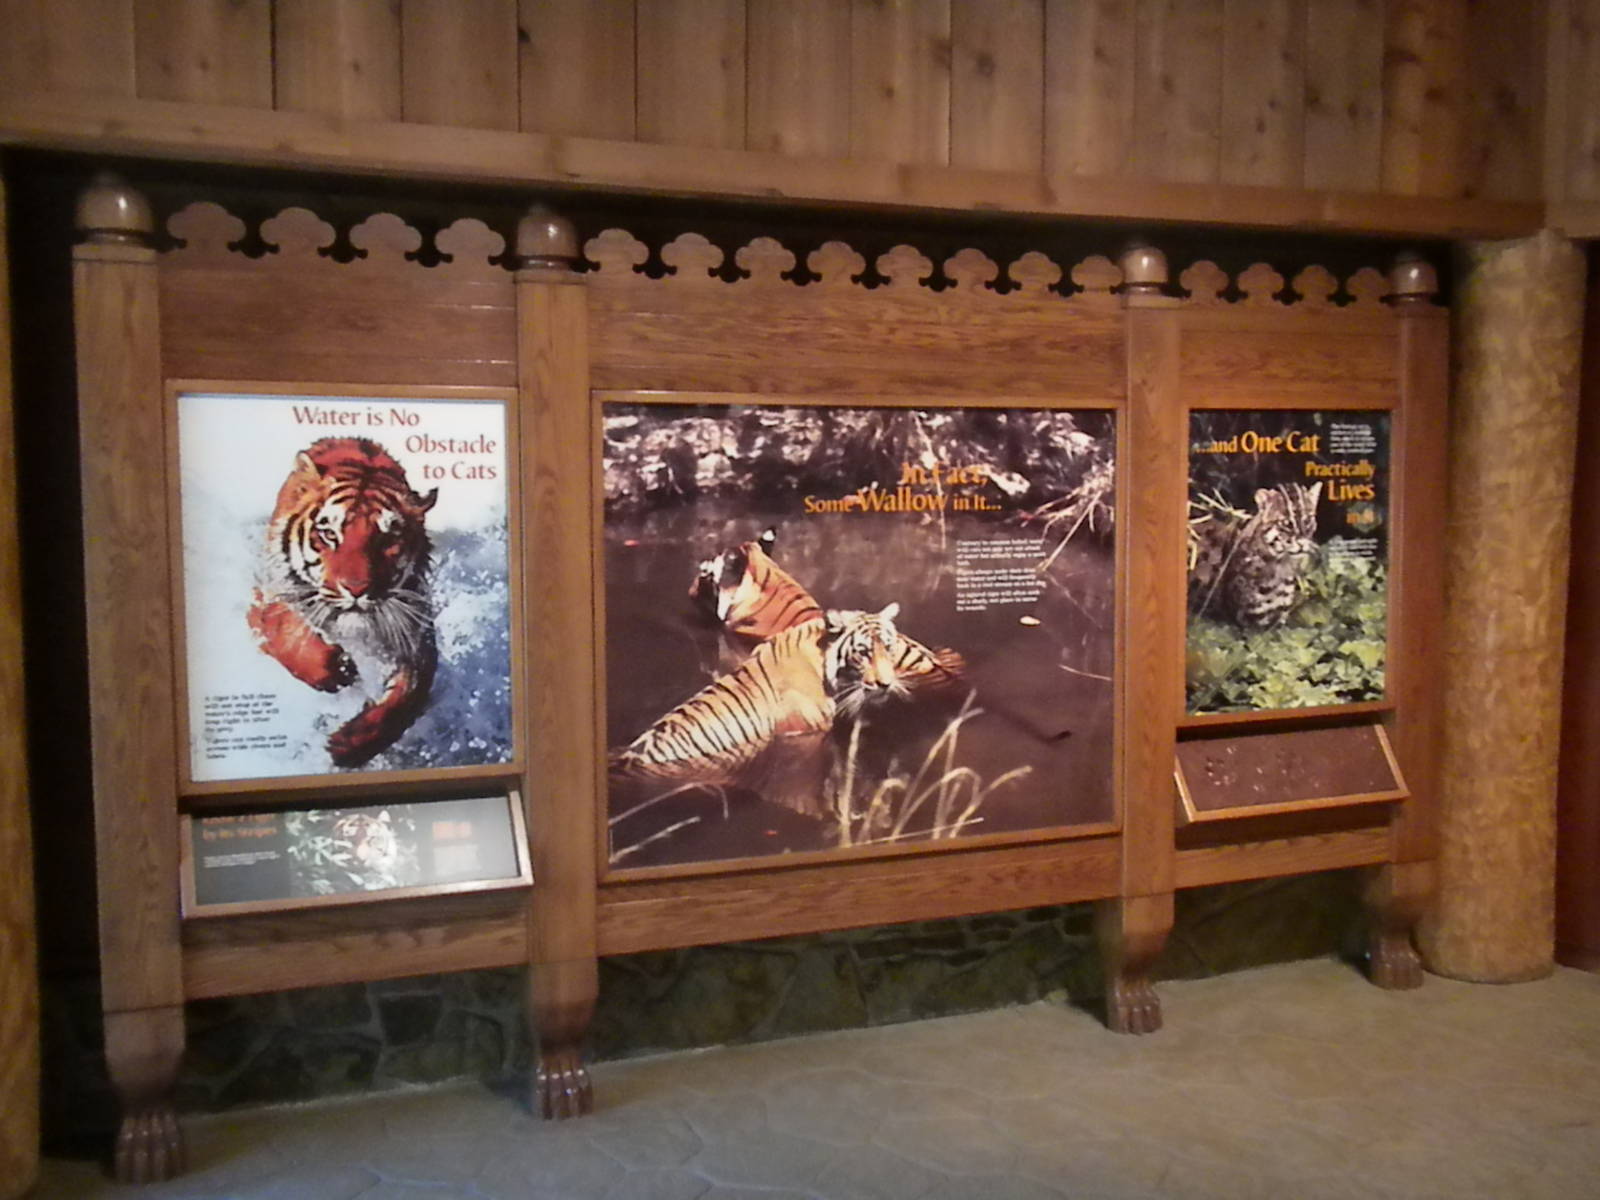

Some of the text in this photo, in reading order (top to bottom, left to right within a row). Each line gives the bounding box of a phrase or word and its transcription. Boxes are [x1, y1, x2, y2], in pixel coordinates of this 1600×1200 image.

[292, 406, 420, 426] Water is No
[405, 433, 497, 453] Obstacle
[1241, 431, 1282, 453] One
[1286, 431, 1320, 453] Cat
[423, 461, 497, 479] to Cats
[1305, 460, 1375, 479] Practically
[804, 494, 853, 513] Some
[857, 485, 948, 512] Wallow
[953, 495, 970, 511] in
[1328, 479, 1375, 501] Lives
